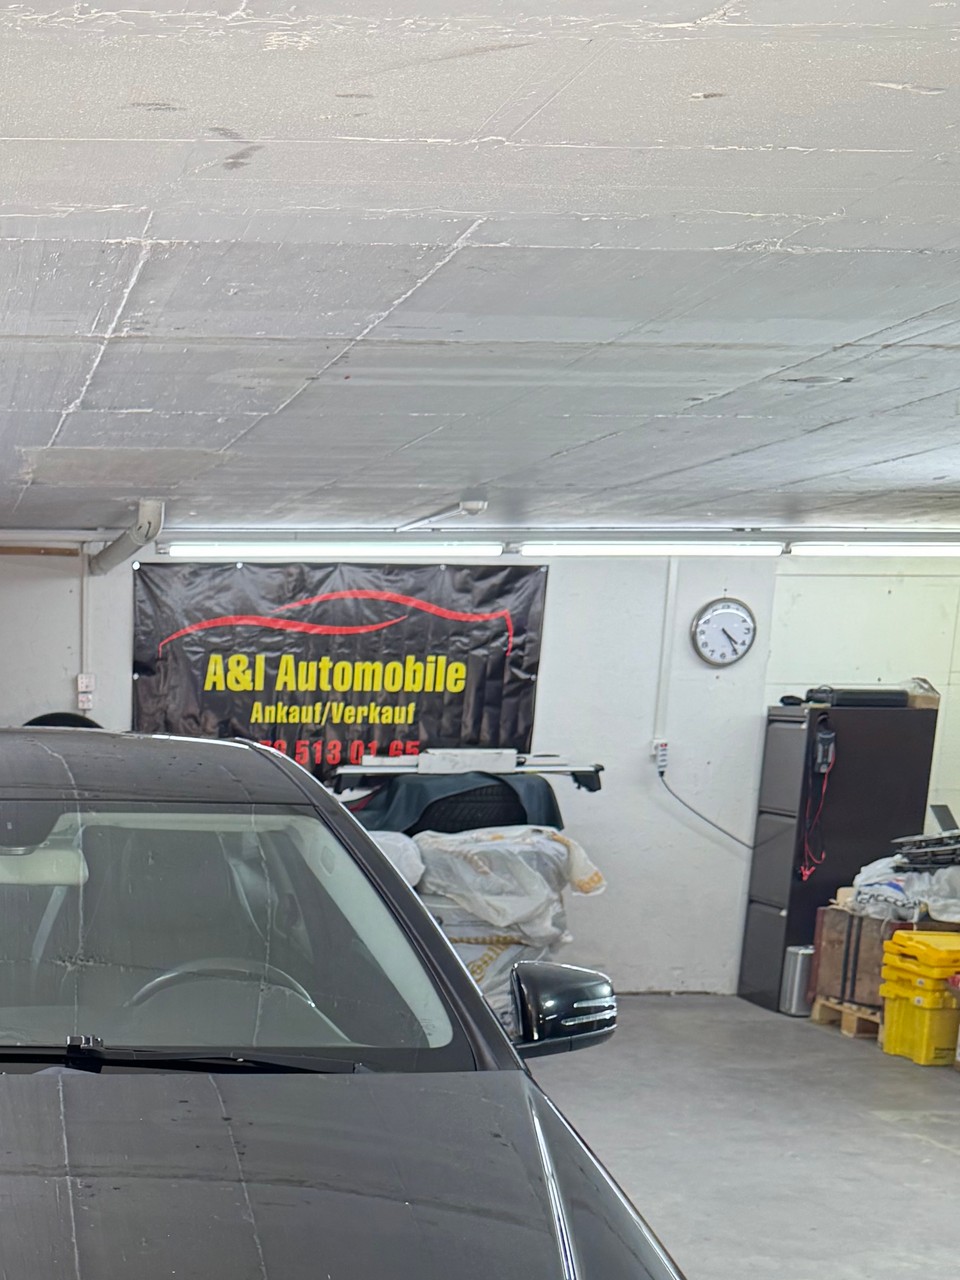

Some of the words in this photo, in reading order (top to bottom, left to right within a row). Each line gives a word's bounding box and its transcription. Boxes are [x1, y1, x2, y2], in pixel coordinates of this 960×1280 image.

[203, 653, 266, 692] A&I
[275, 653, 467, 693] Automobile
[249, 701, 416, 726] Ankauf/Verkauf
[294, 740, 342, 766] 513
[350, 740, 378, 766] 01
